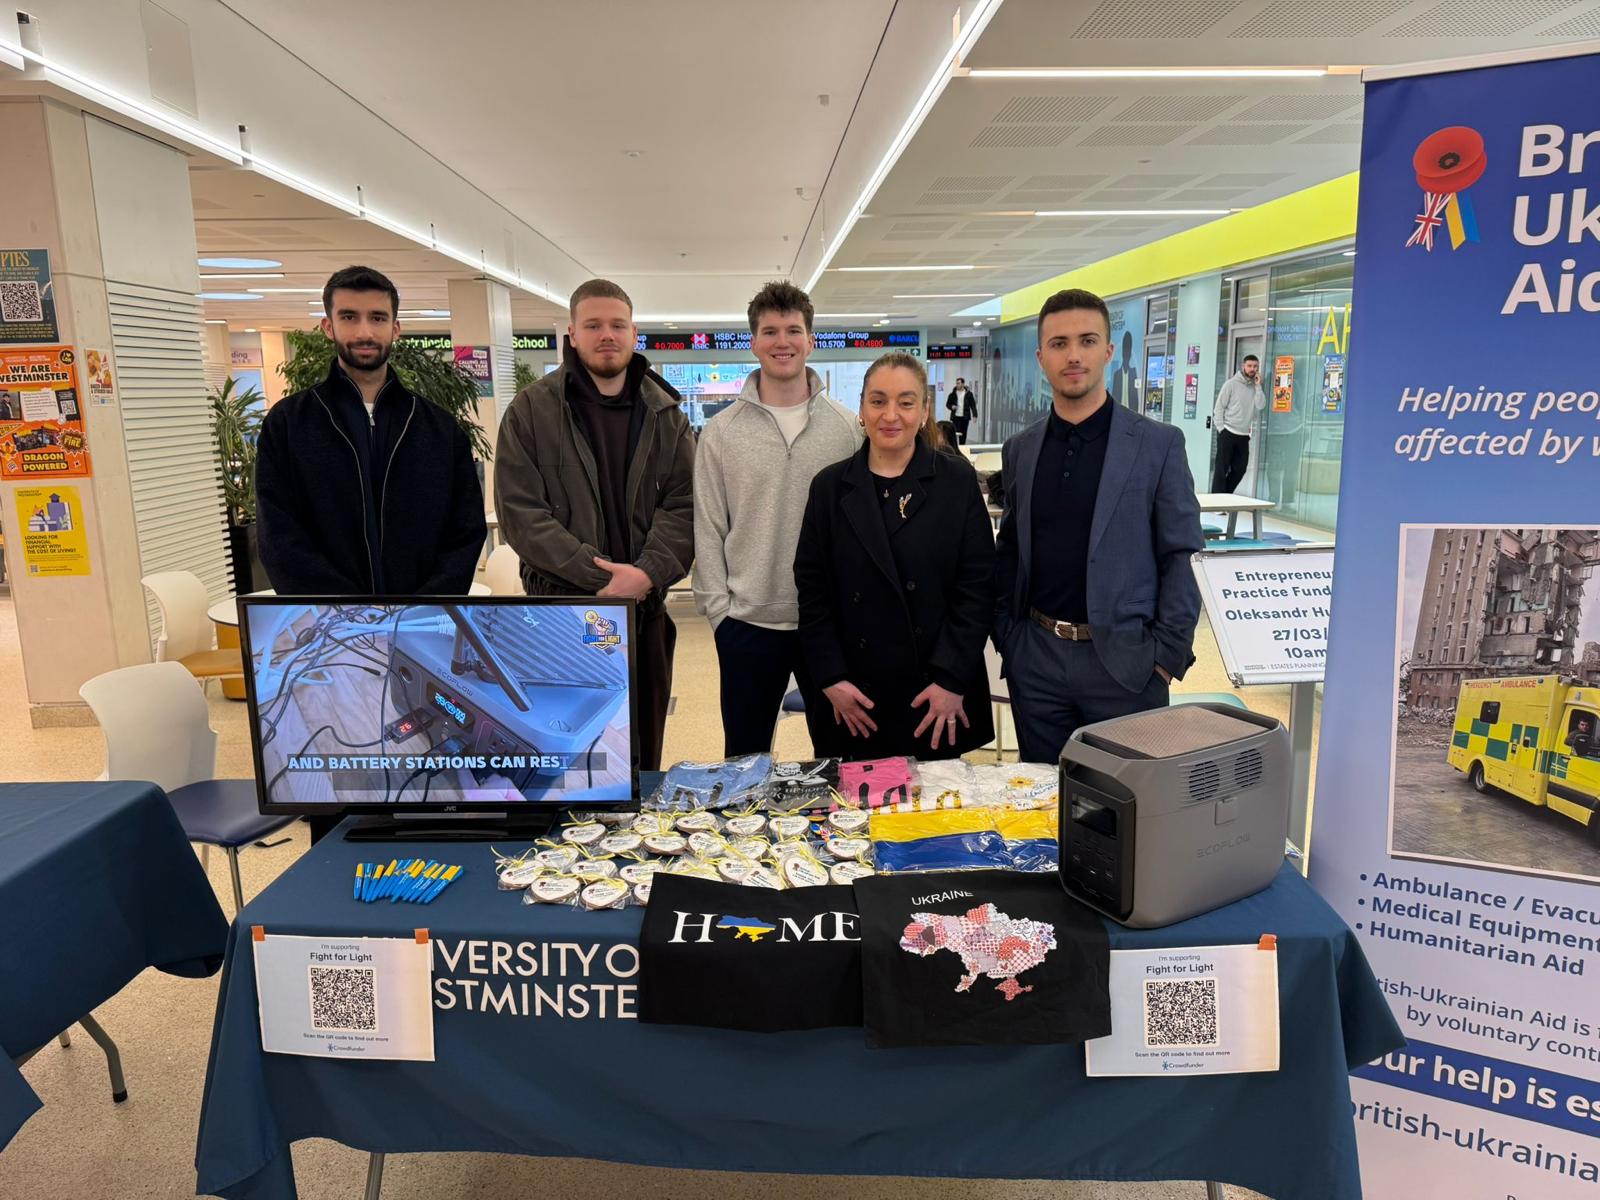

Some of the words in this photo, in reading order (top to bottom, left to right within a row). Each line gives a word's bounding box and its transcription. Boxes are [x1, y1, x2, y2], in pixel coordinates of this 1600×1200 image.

[512, 336, 548, 349] School
[714, 333, 736, 341] HSBC
[815, 332, 846, 340] Vodafone
[847, 332, 869, 340] Group
[9, 365, 26, 373] WE
[31, 364, 50, 372] ARE
[1397, 385, 1527, 420] Helping
[1530, 391, 1600, 420] peo
[1394, 428, 1533, 462] affected
[1538, 428, 1584, 464] by
[23, 453, 64, 461] DRAGON
[23, 463, 67, 471] POWERED
[1235, 571, 1333, 583] Entrepreneu
[1222, 587, 1288, 599] Practice
[1292, 585, 1332, 597] Fund
[1225, 607, 1308, 621] Oleksandr
[1284, 647, 1327, 659] 10am
[288, 757, 324, 769] AND
[328, 757, 403, 769] BATTERY
[405, 756, 486, 769] STATIONS
[490, 756, 526, 768] CAN
[1372, 872, 1507, 909] Ambulance
[1372, 896, 1462, 926] Medical
[1370, 921, 1536, 967] Humanitarian
[1542, 954, 1585, 976] Aid
[310, 952, 333, 961] Fight
[349, 953, 373, 962] Light
[1146, 965, 1171, 975] Fight
[1173, 964, 1187, 972] for
[1189, 963, 1214, 973] Light
[434, 978, 638, 1019] STMINSTE
[1529, 1010, 1567, 1032] Aid
[1573, 1018, 1591, 1036] is
[1407, 1005, 1431, 1027] by
[1436, 1014, 1541, 1051] voluntary
[1546, 1039, 1600, 1064] cont
[1368, 1050, 1426, 1076] ur
[1433, 1055, 1517, 1104] help
[1526, 1076, 1558, 1110] is
